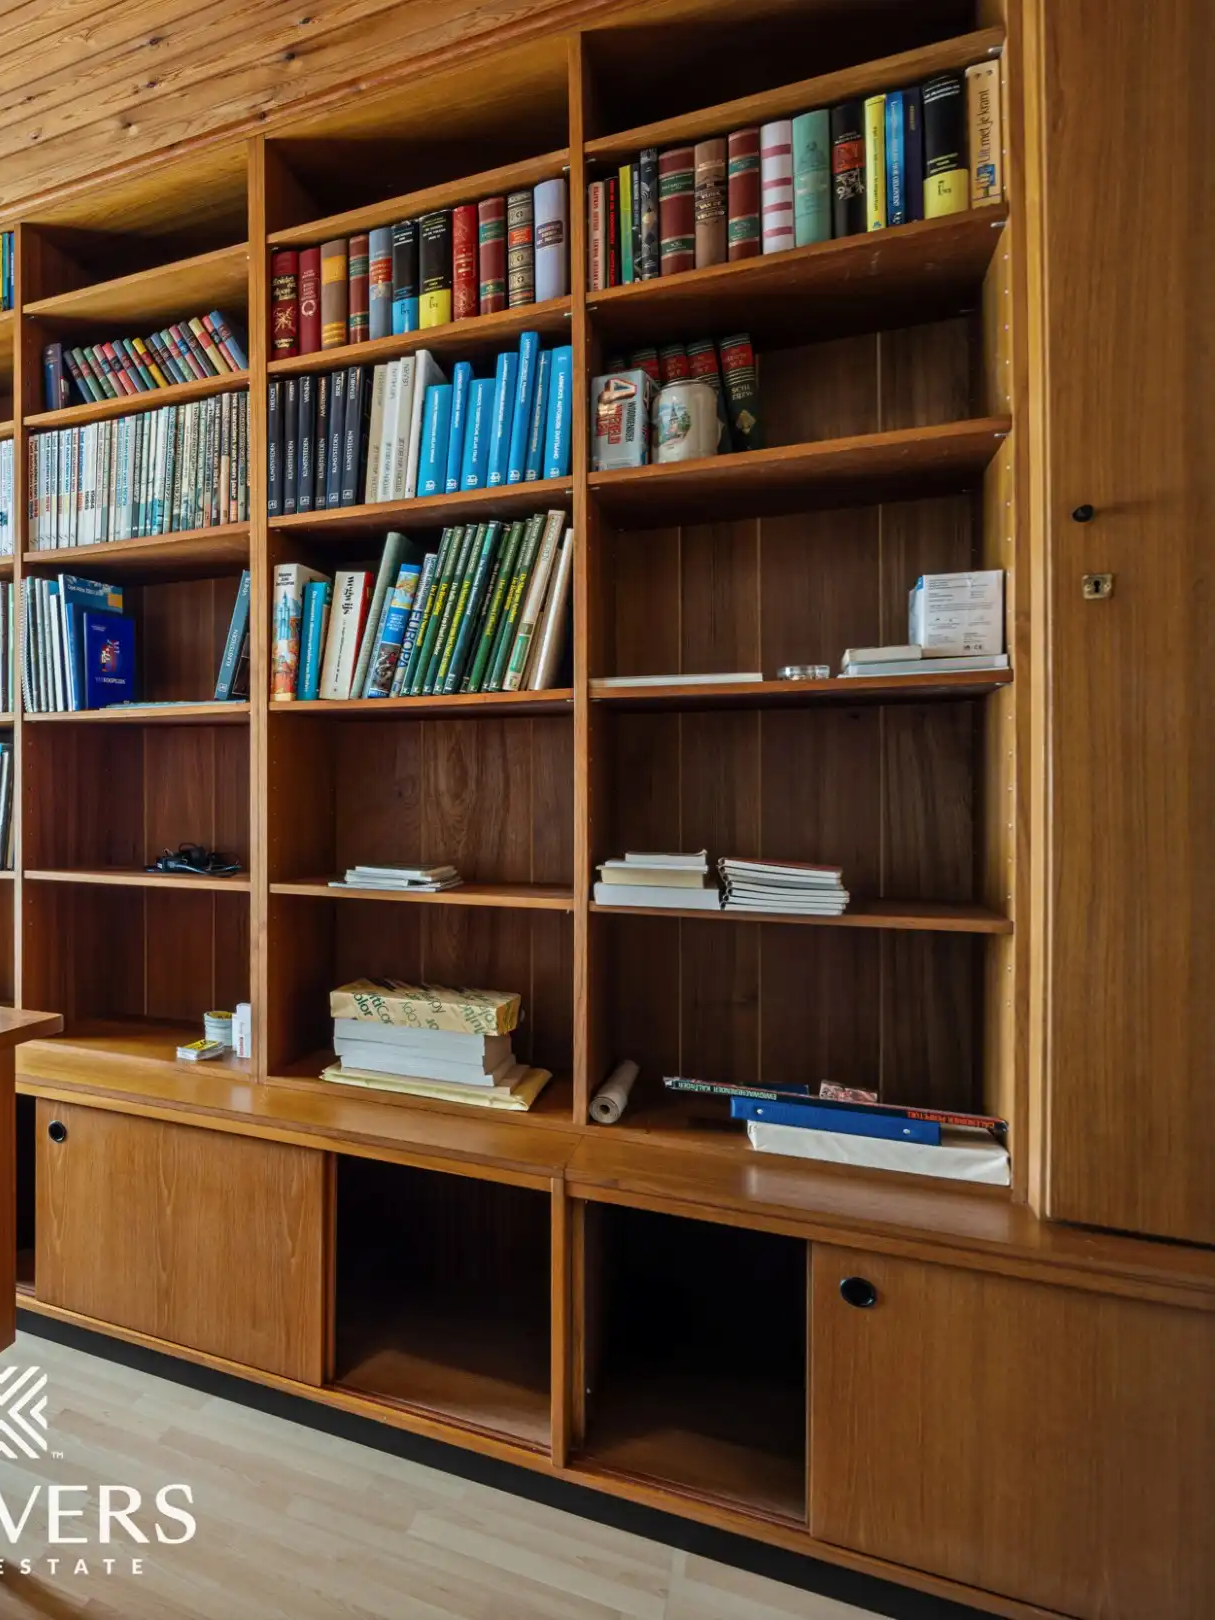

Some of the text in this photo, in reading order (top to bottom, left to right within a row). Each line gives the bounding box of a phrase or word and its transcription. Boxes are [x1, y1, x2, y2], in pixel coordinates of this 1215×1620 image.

[398, 610, 423, 667] EUROPA
[434, 637, 444, 655] Harbor
[677, 1082, 711, 1093] KALENDER
